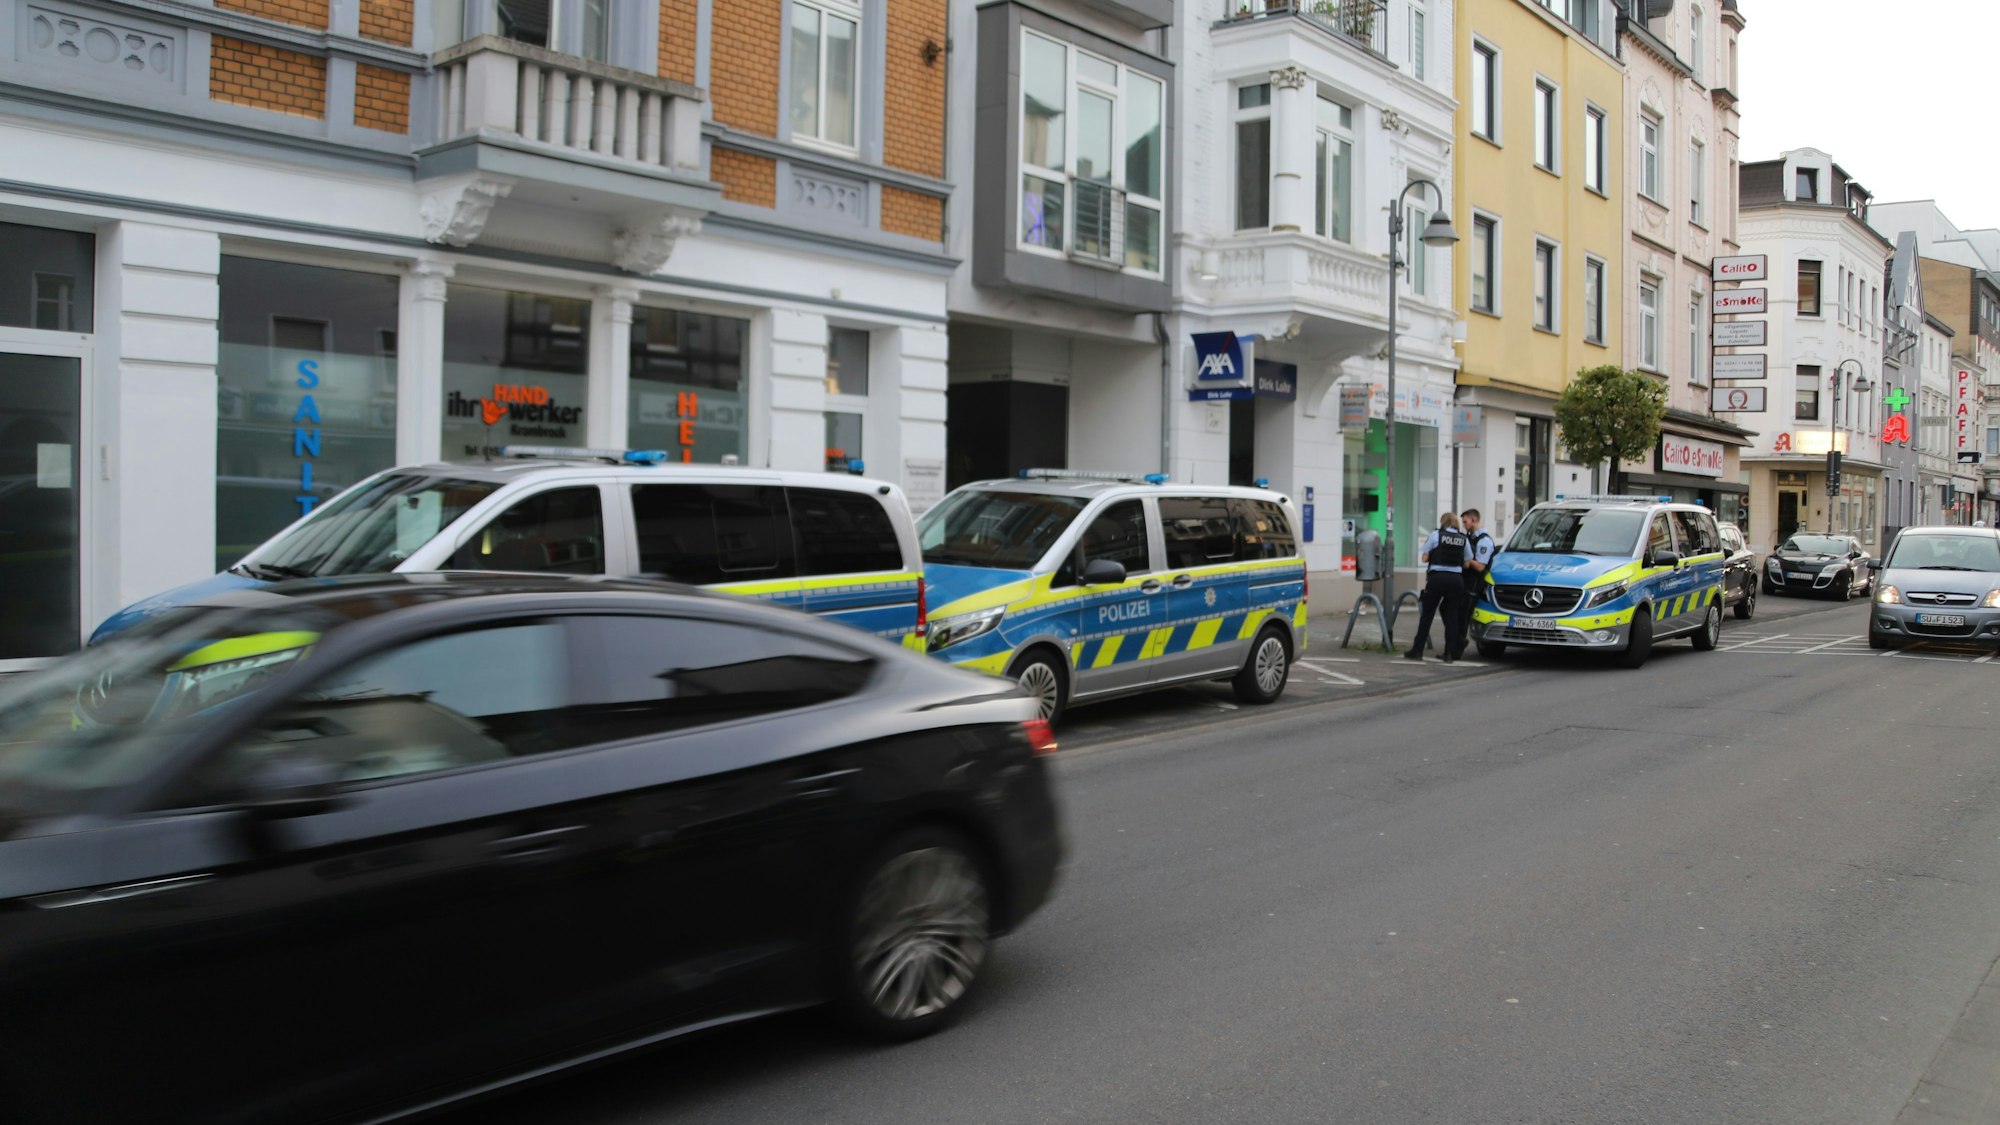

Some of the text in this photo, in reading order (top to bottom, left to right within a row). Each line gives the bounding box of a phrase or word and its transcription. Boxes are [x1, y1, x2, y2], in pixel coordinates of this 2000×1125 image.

[1198, 352, 1235, 376] AXA
[494, 384, 549, 406] HAND
[1207, 391, 1219, 399] Dirk
[1259, 377, 1275, 391] Dirk
[447, 391, 582, 424] ihr werker
[1957, 371, 1969, 448] PFAFF
[1441, 535, 1465, 546] POLIZEI
[1512, 563, 1580, 574] POLIZEI
[1098, 599, 1150, 624] POLIZEI
